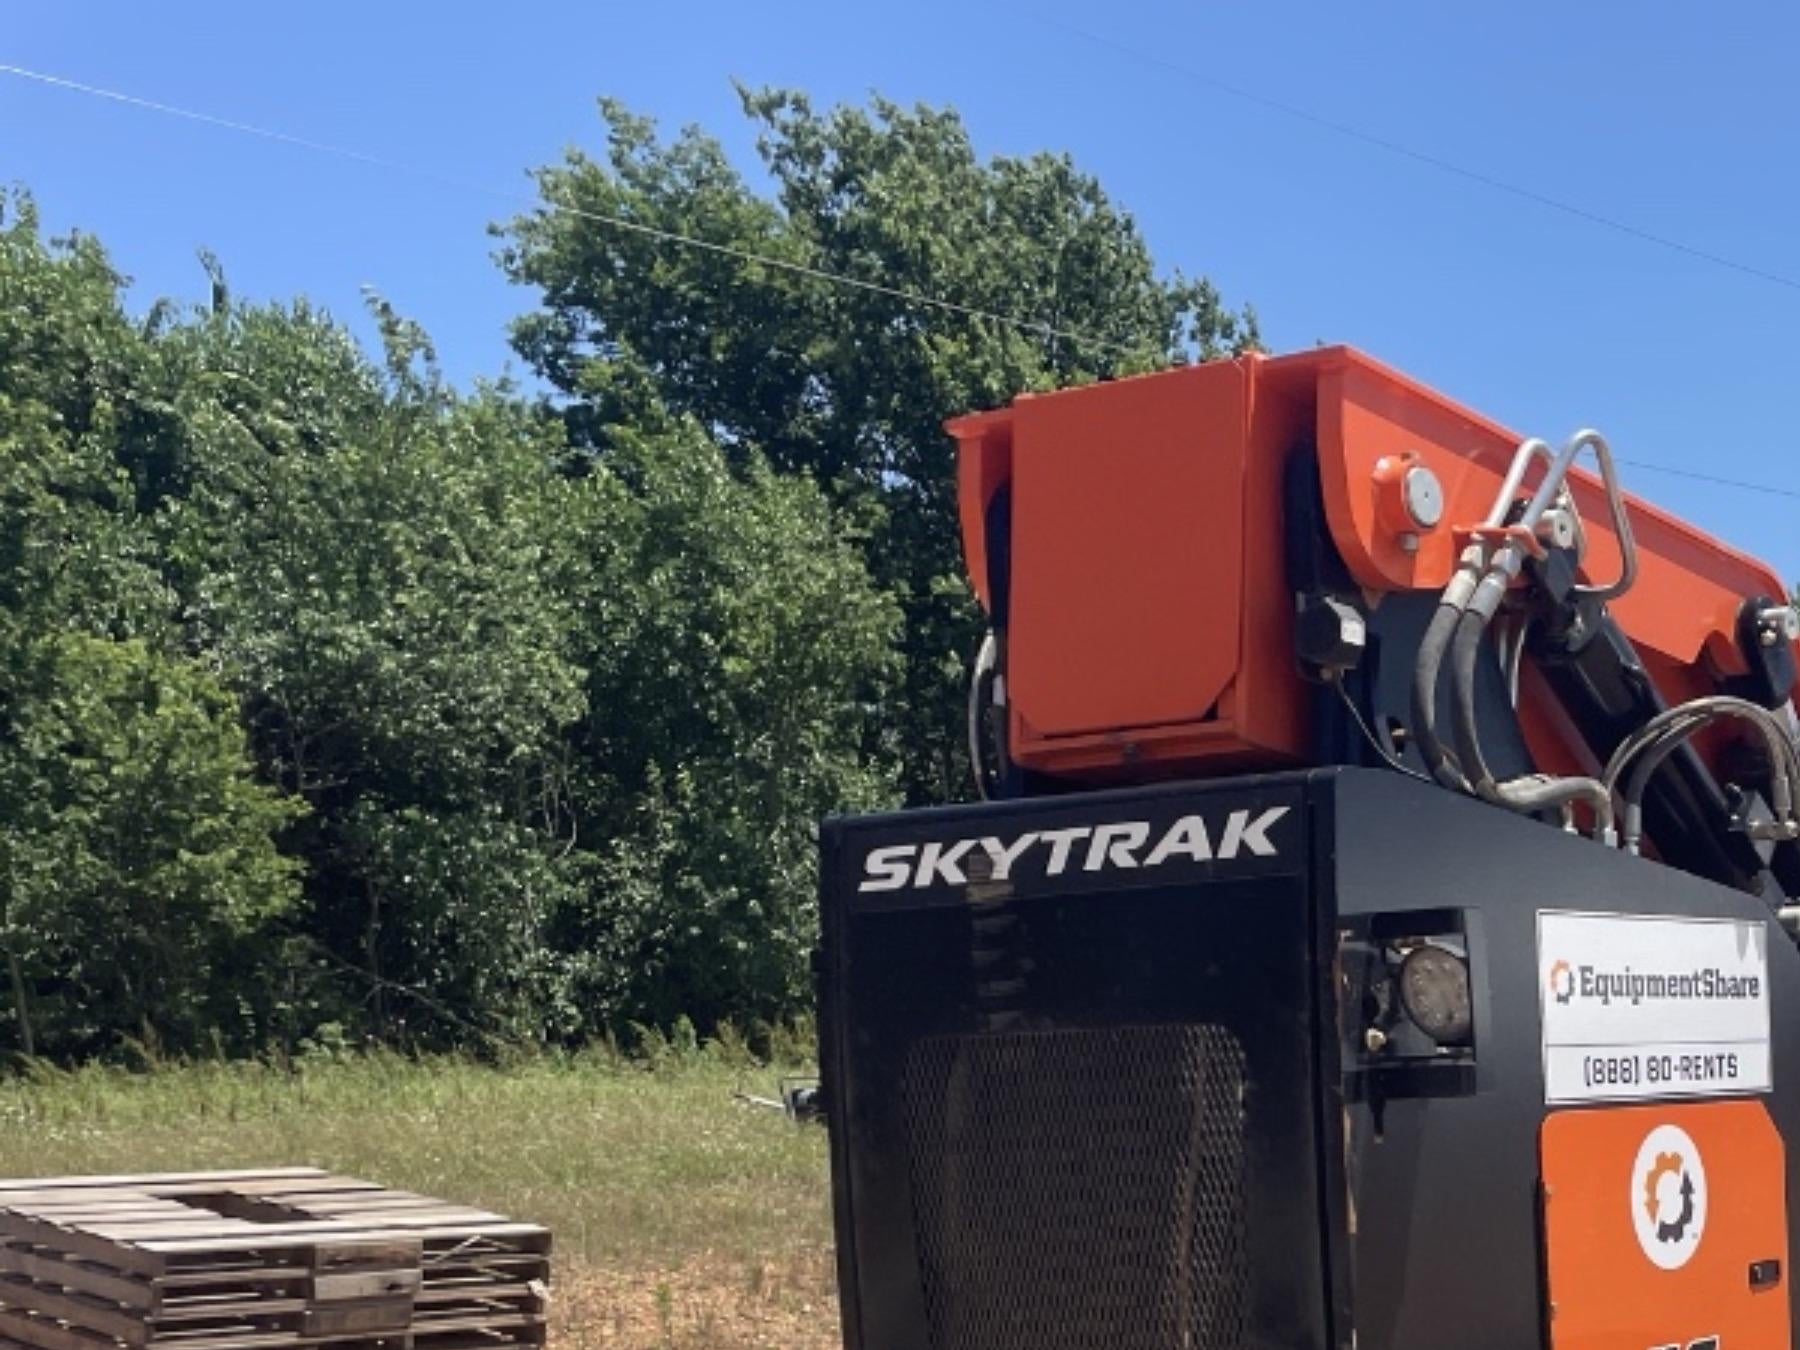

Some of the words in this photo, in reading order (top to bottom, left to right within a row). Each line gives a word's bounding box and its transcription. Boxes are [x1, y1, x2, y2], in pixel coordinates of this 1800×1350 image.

[857, 806, 1291, 893] SKYTRAK
[1578, 965, 1760, 1005] EquipmentShare
[1584, 1055, 1639, 1087] (888)
[1647, 1053, 1738, 1083] 80-RENTS
